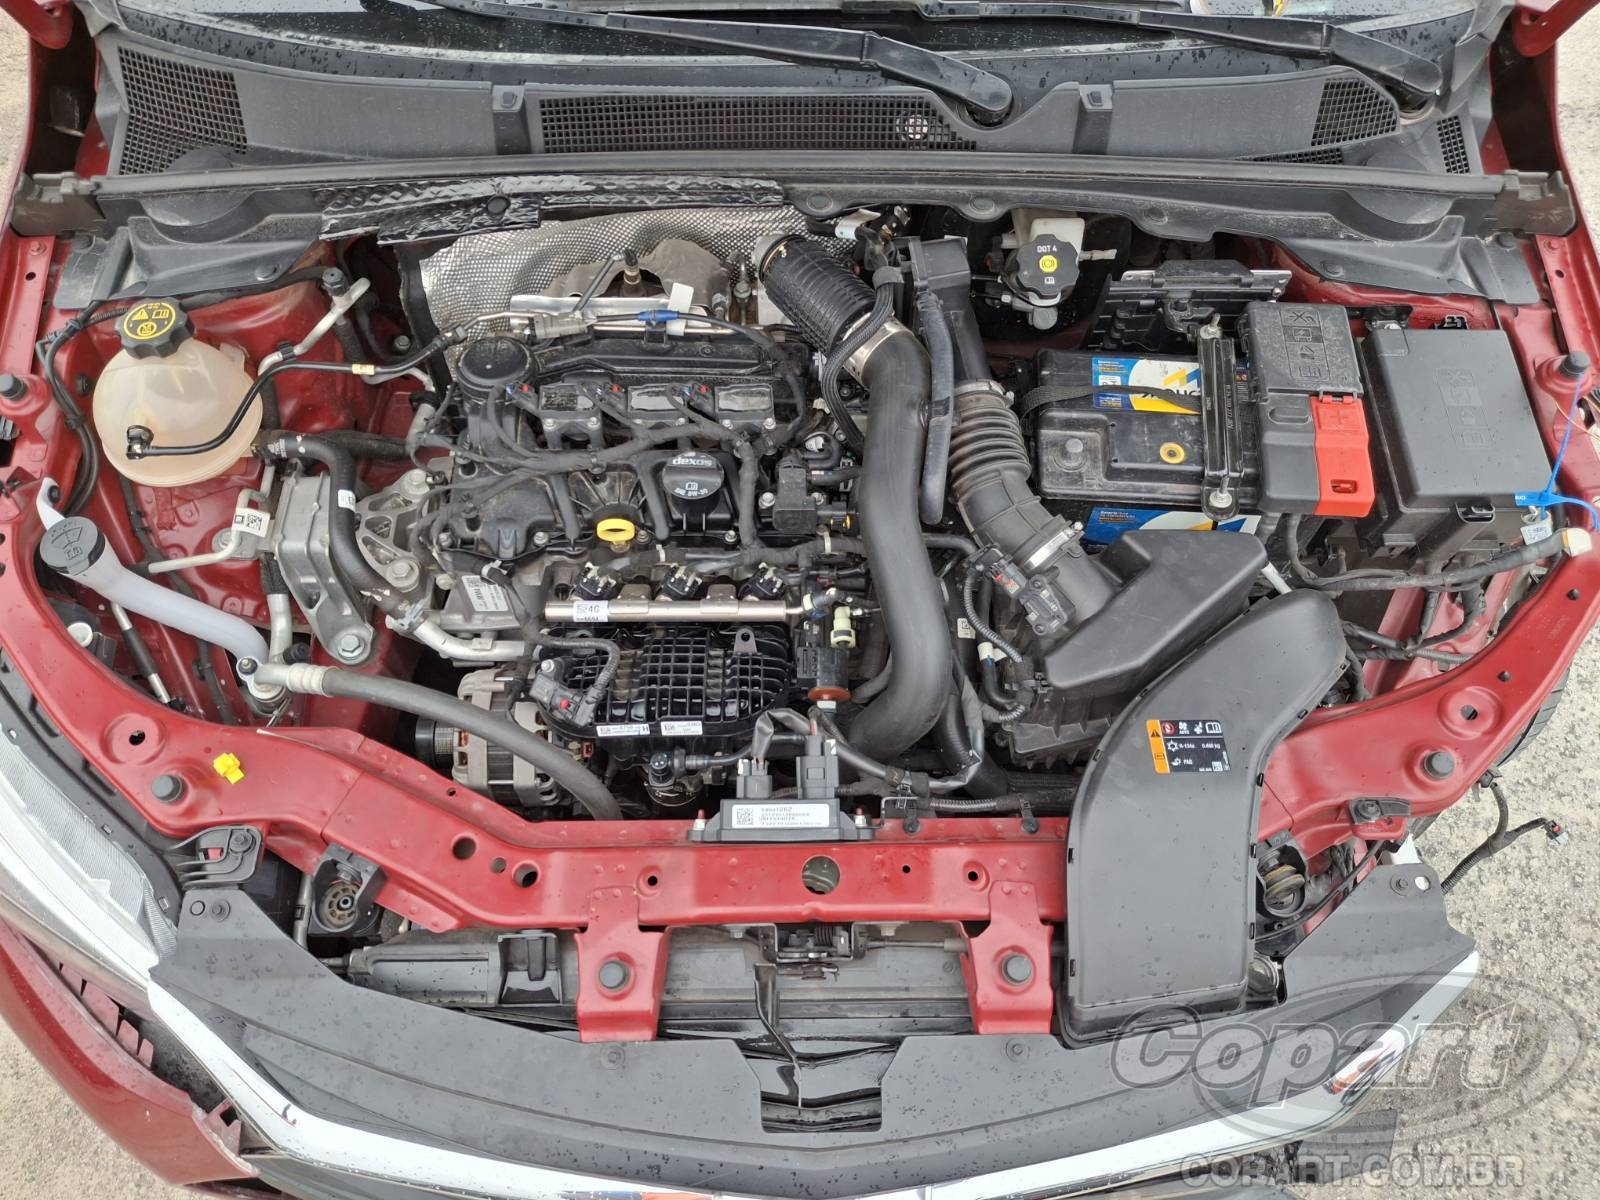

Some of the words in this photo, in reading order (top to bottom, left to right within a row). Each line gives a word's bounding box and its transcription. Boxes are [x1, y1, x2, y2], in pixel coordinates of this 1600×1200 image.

[1037, 245, 1051, 253] DOT
[1052, 245, 1058, 253] 4
[672, 456, 713, 467] dexos
